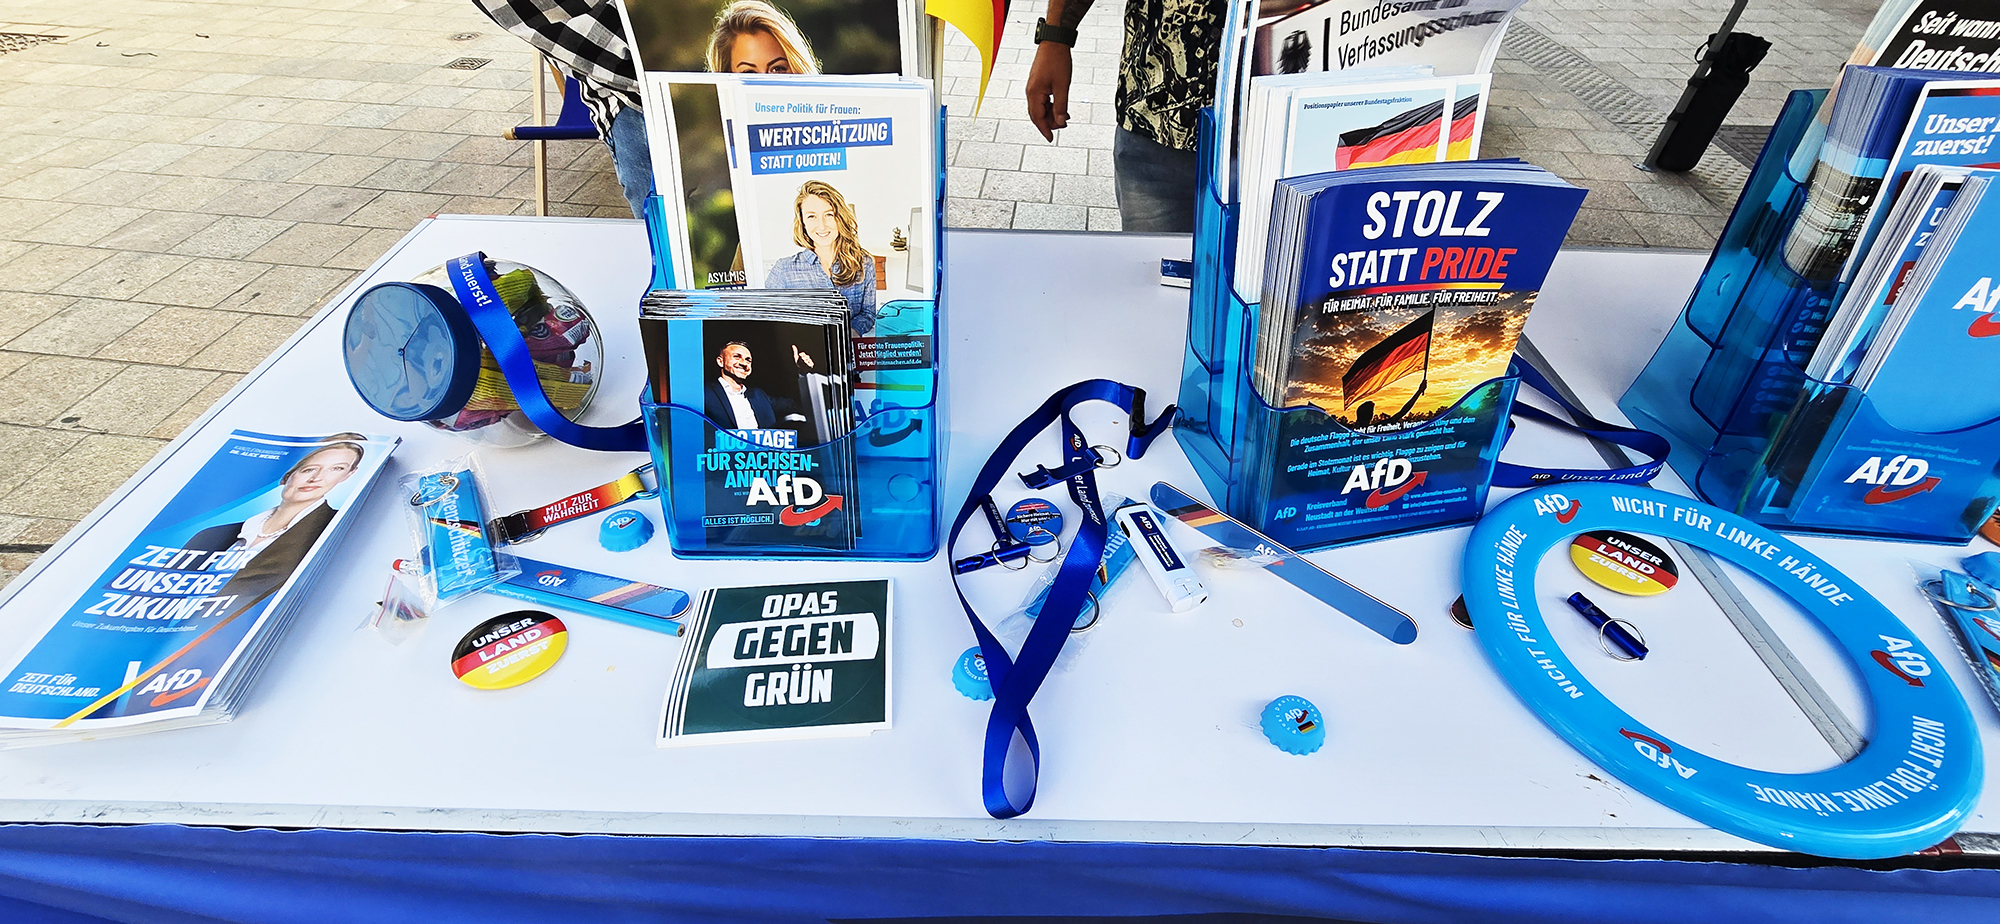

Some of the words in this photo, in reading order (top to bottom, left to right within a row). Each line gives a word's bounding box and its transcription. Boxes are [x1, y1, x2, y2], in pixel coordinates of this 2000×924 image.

[1912, 10, 1957, 34] Seit
[755, 102, 785, 113] Unsere
[787, 103, 814, 113] Politik
[815, 103, 828, 114] für
[829, 104, 861, 115] Frauen:
[1304, 102, 1343, 110] Positionspapier
[758, 119, 888, 147] WERTSCHÄTZUNG
[1923, 114, 1995, 135] Unser
[1911, 134, 1995, 156] zuerst!
[760, 154, 794, 170] STATT
[795, 152, 841, 169] QUOTEN!
[1362, 190, 1505, 240] STOLZ
[708, 270, 746, 283] ASYLMIS
[1329, 248, 1418, 288] STATT
[1419, 247, 1518, 281] PRIDE
[462, 269, 492, 306] zuerst!
[1322, 299, 1340, 314] FÜR
[1340, 296, 1374, 311] HEIMAT.
[1374, 293, 1394, 308] FÜR
[1393, 292, 1431, 306] FAMILIE.
[1432, 289, 1452, 304] FÜR
[1453, 291, 1498, 304] FREIHEIT.
[857, 342, 867, 350] Für
[868, 342, 884, 350] echte
[885, 341, 925, 350] Frauenpolitik:
[859, 350, 874, 359] Jetzt
[875, 349, 897, 358] Mitglied
[898, 349, 922, 357] werden!
[717, 431, 748, 450] 100
[752, 430, 795, 449] TAGE
[1367, 424, 1376, 434] für
[696, 448, 731, 472] FÜR
[734, 452, 819, 472] SACHSEN-
[1843, 455, 1929, 485] AfD
[1340, 458, 1413, 495] AfD
[1608, 469, 1647, 480] Land
[746, 474, 823, 506] AfD
[543, 498, 599, 523] WAHRHEIT
[545, 500, 568, 515] MUT
[570, 493, 592, 507] ZUR
[1274, 506, 1297, 521] AfD
[1305, 511, 1334, 522] Neustadt
[1343, 508, 1355, 517] der
[1306, 498, 1348, 511] Kreisverband
[1534, 493, 1570, 516] AfD
[609, 516, 630, 529] AfD
[705, 517, 727, 526] ALLES
[728, 517, 739, 525] IST
[740, 514, 772, 524] MÖGLICH.
[1140, 516, 1153, 529] AfD
[129, 545, 207, 571] ZEIT
[197, 546, 258, 571] FÜR
[1493, 523, 1528, 566] HÄNDE
[1607, 536, 1663, 567] UNSER
[1611, 496, 1667, 518] NICHT
[1673, 507, 1712, 532] FÜR
[1715, 522, 1781, 561] LINKE
[1778, 555, 1854, 606] HÄNDE
[1588, 553, 1648, 585] ZUERST
[1596, 544, 1655, 576] LAND
[111, 568, 233, 595] UNSERE
[538, 575, 567, 587] AfD
[1494, 565, 1521, 609] LINKE
[83, 592, 239, 620] ZUKUNFT!
[761, 591, 838, 619] OPAS
[472, 617, 535, 648] UNSER
[1507, 608, 1537, 644] FÜR
[478, 628, 542, 662] LAND
[733, 621, 854, 660] GEGEN
[486, 640, 548, 674] ZUERST
[1878, 634, 1932, 677] AfD
[17, 672, 53, 683] ZEIT
[50, 673, 77, 685] FÜR
[137, 668, 203, 696] AfD
[743, 663, 833, 707] GRÜN
[1528, 646, 1584, 700] NICHT
[8, 683, 101, 697] DEUTSCHLAND.
[1284, 708, 1303, 722] AfD
[1908, 715, 1946, 769] NICHT
[1634, 740, 1698, 780] AfD
[1887, 765, 1939, 793] FÜR
[1746, 782, 1844, 817] HÄNDE
[1844, 780, 1910, 813] LINKE
